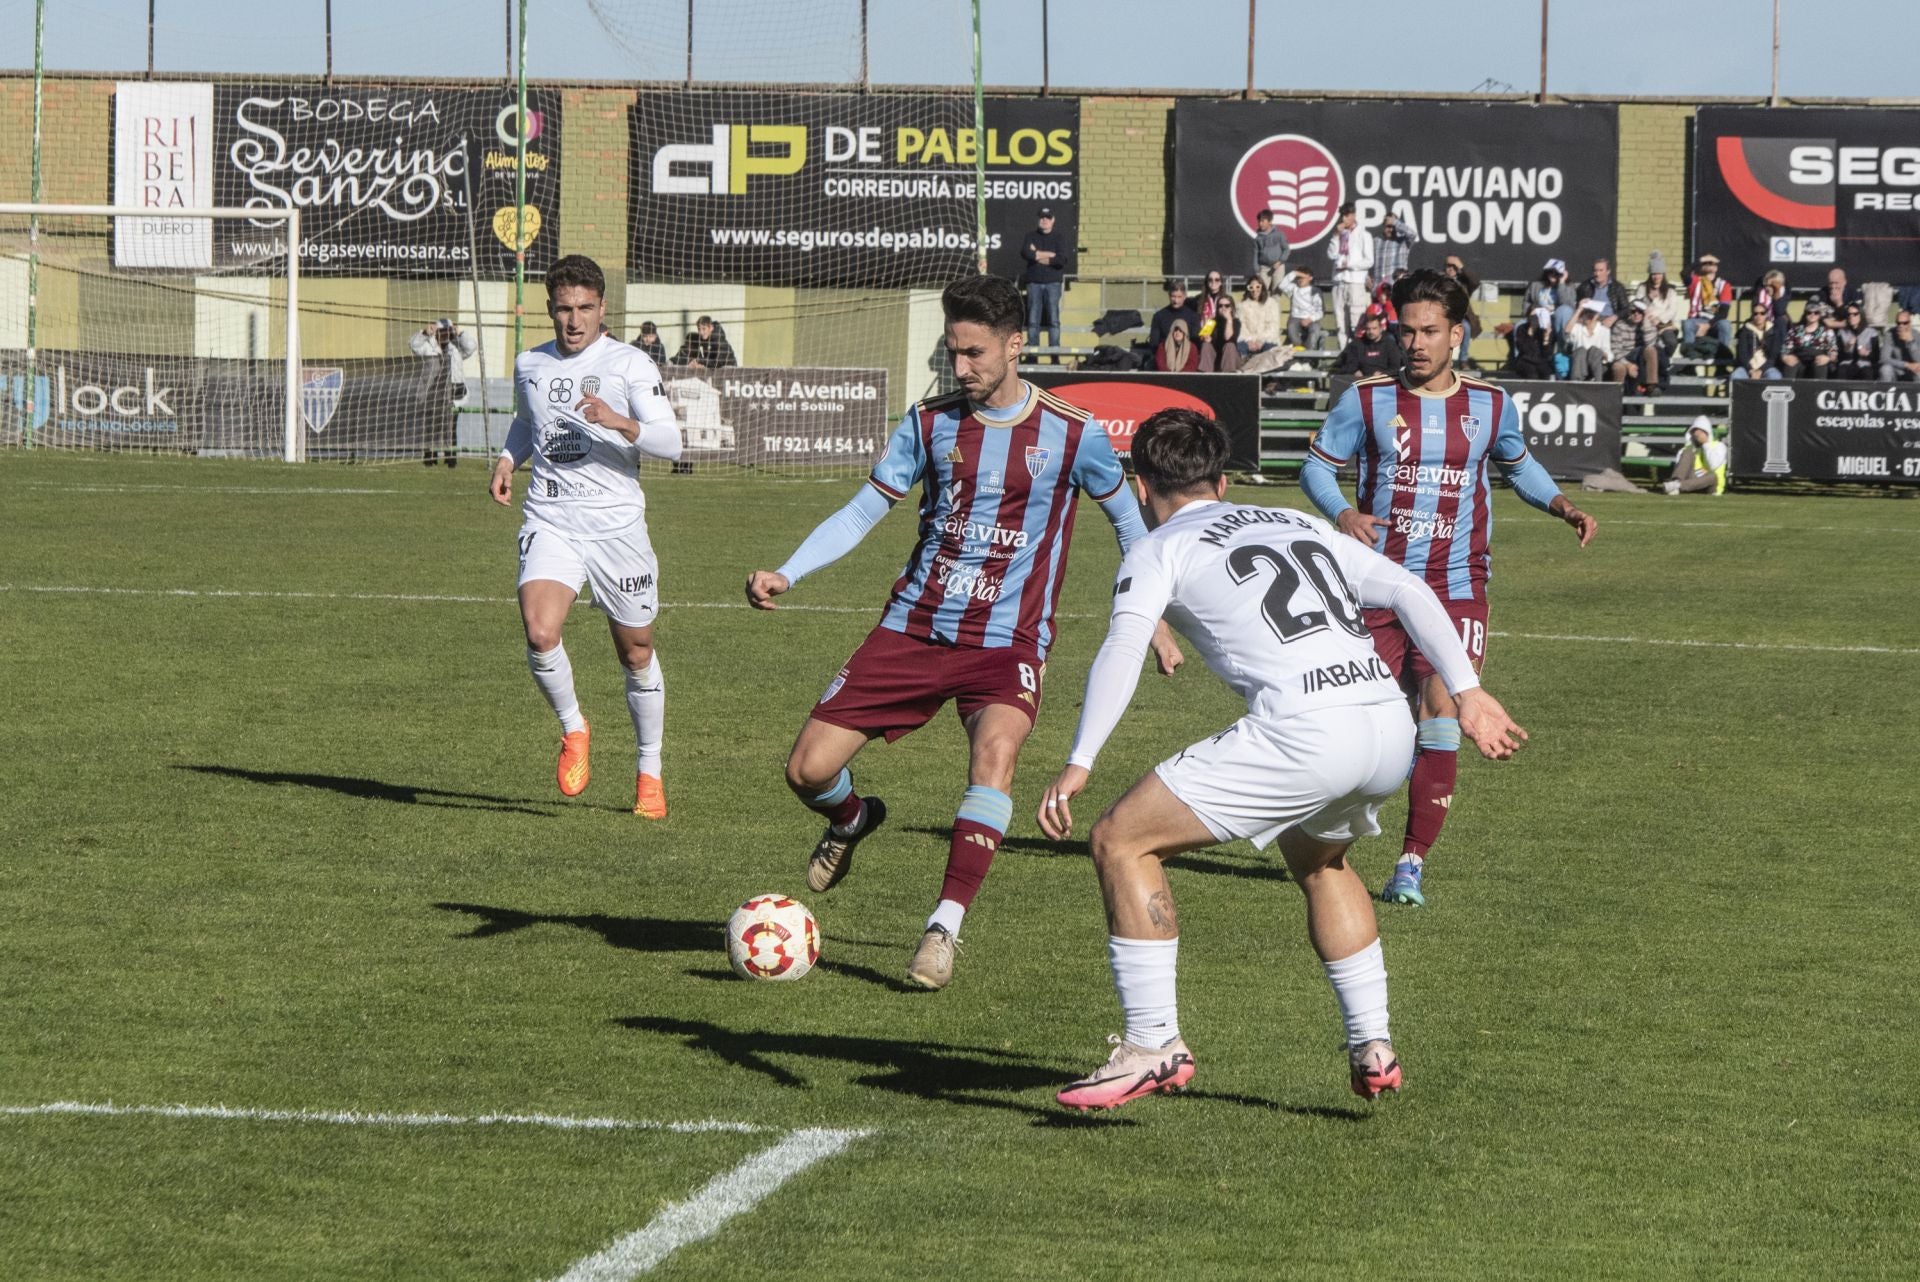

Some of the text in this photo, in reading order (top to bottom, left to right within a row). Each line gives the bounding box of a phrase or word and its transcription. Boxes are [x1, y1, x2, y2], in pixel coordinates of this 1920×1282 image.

[288, 97, 441, 128] BODEGA
[231, 97, 468, 176] Severino
[825, 127, 1073, 166] DE PABLOS
[1789, 146, 1920, 186] SEG
[244, 161, 441, 228] Sanz
[824, 175, 1072, 200] CORREDURÍA DE SEGUROS
[1355, 165, 1563, 199] OCTAVIANO
[142, 222, 194, 235] DUERO
[1356, 199, 1563, 245] PALOMO
[231, 237, 470, 262] www.bdegaseverinosanz.es
[725, 380, 877, 400] Hotel Avenida
[1816, 386, 1913, 412] GARCÍA
[776, 401, 845, 412] del Sotillo
[59, 421, 178, 433] TECHNOLOGIES
[1816, 413, 1885, 431] escayolas
[545, 430, 581, 442] Estrella
[546, 441, 581, 453] Galicia
[763, 436, 875, 454] Tlf 921 44 54 14
[1387, 461, 1470, 486] cajaviva
[1837, 456, 1891, 476] MIGUEL
[980, 486, 1005, 495] SEGOVIA
[1427, 488, 1465, 499] Fundación
[1392, 508, 1430, 519] amanece
[1199, 509, 1290, 548] MARCOS
[620, 573, 653, 592] LEYMA
[1226, 540, 1373, 644] 20
[1461, 618, 1483, 656] 18
[1018, 662, 1036, 692] 8
